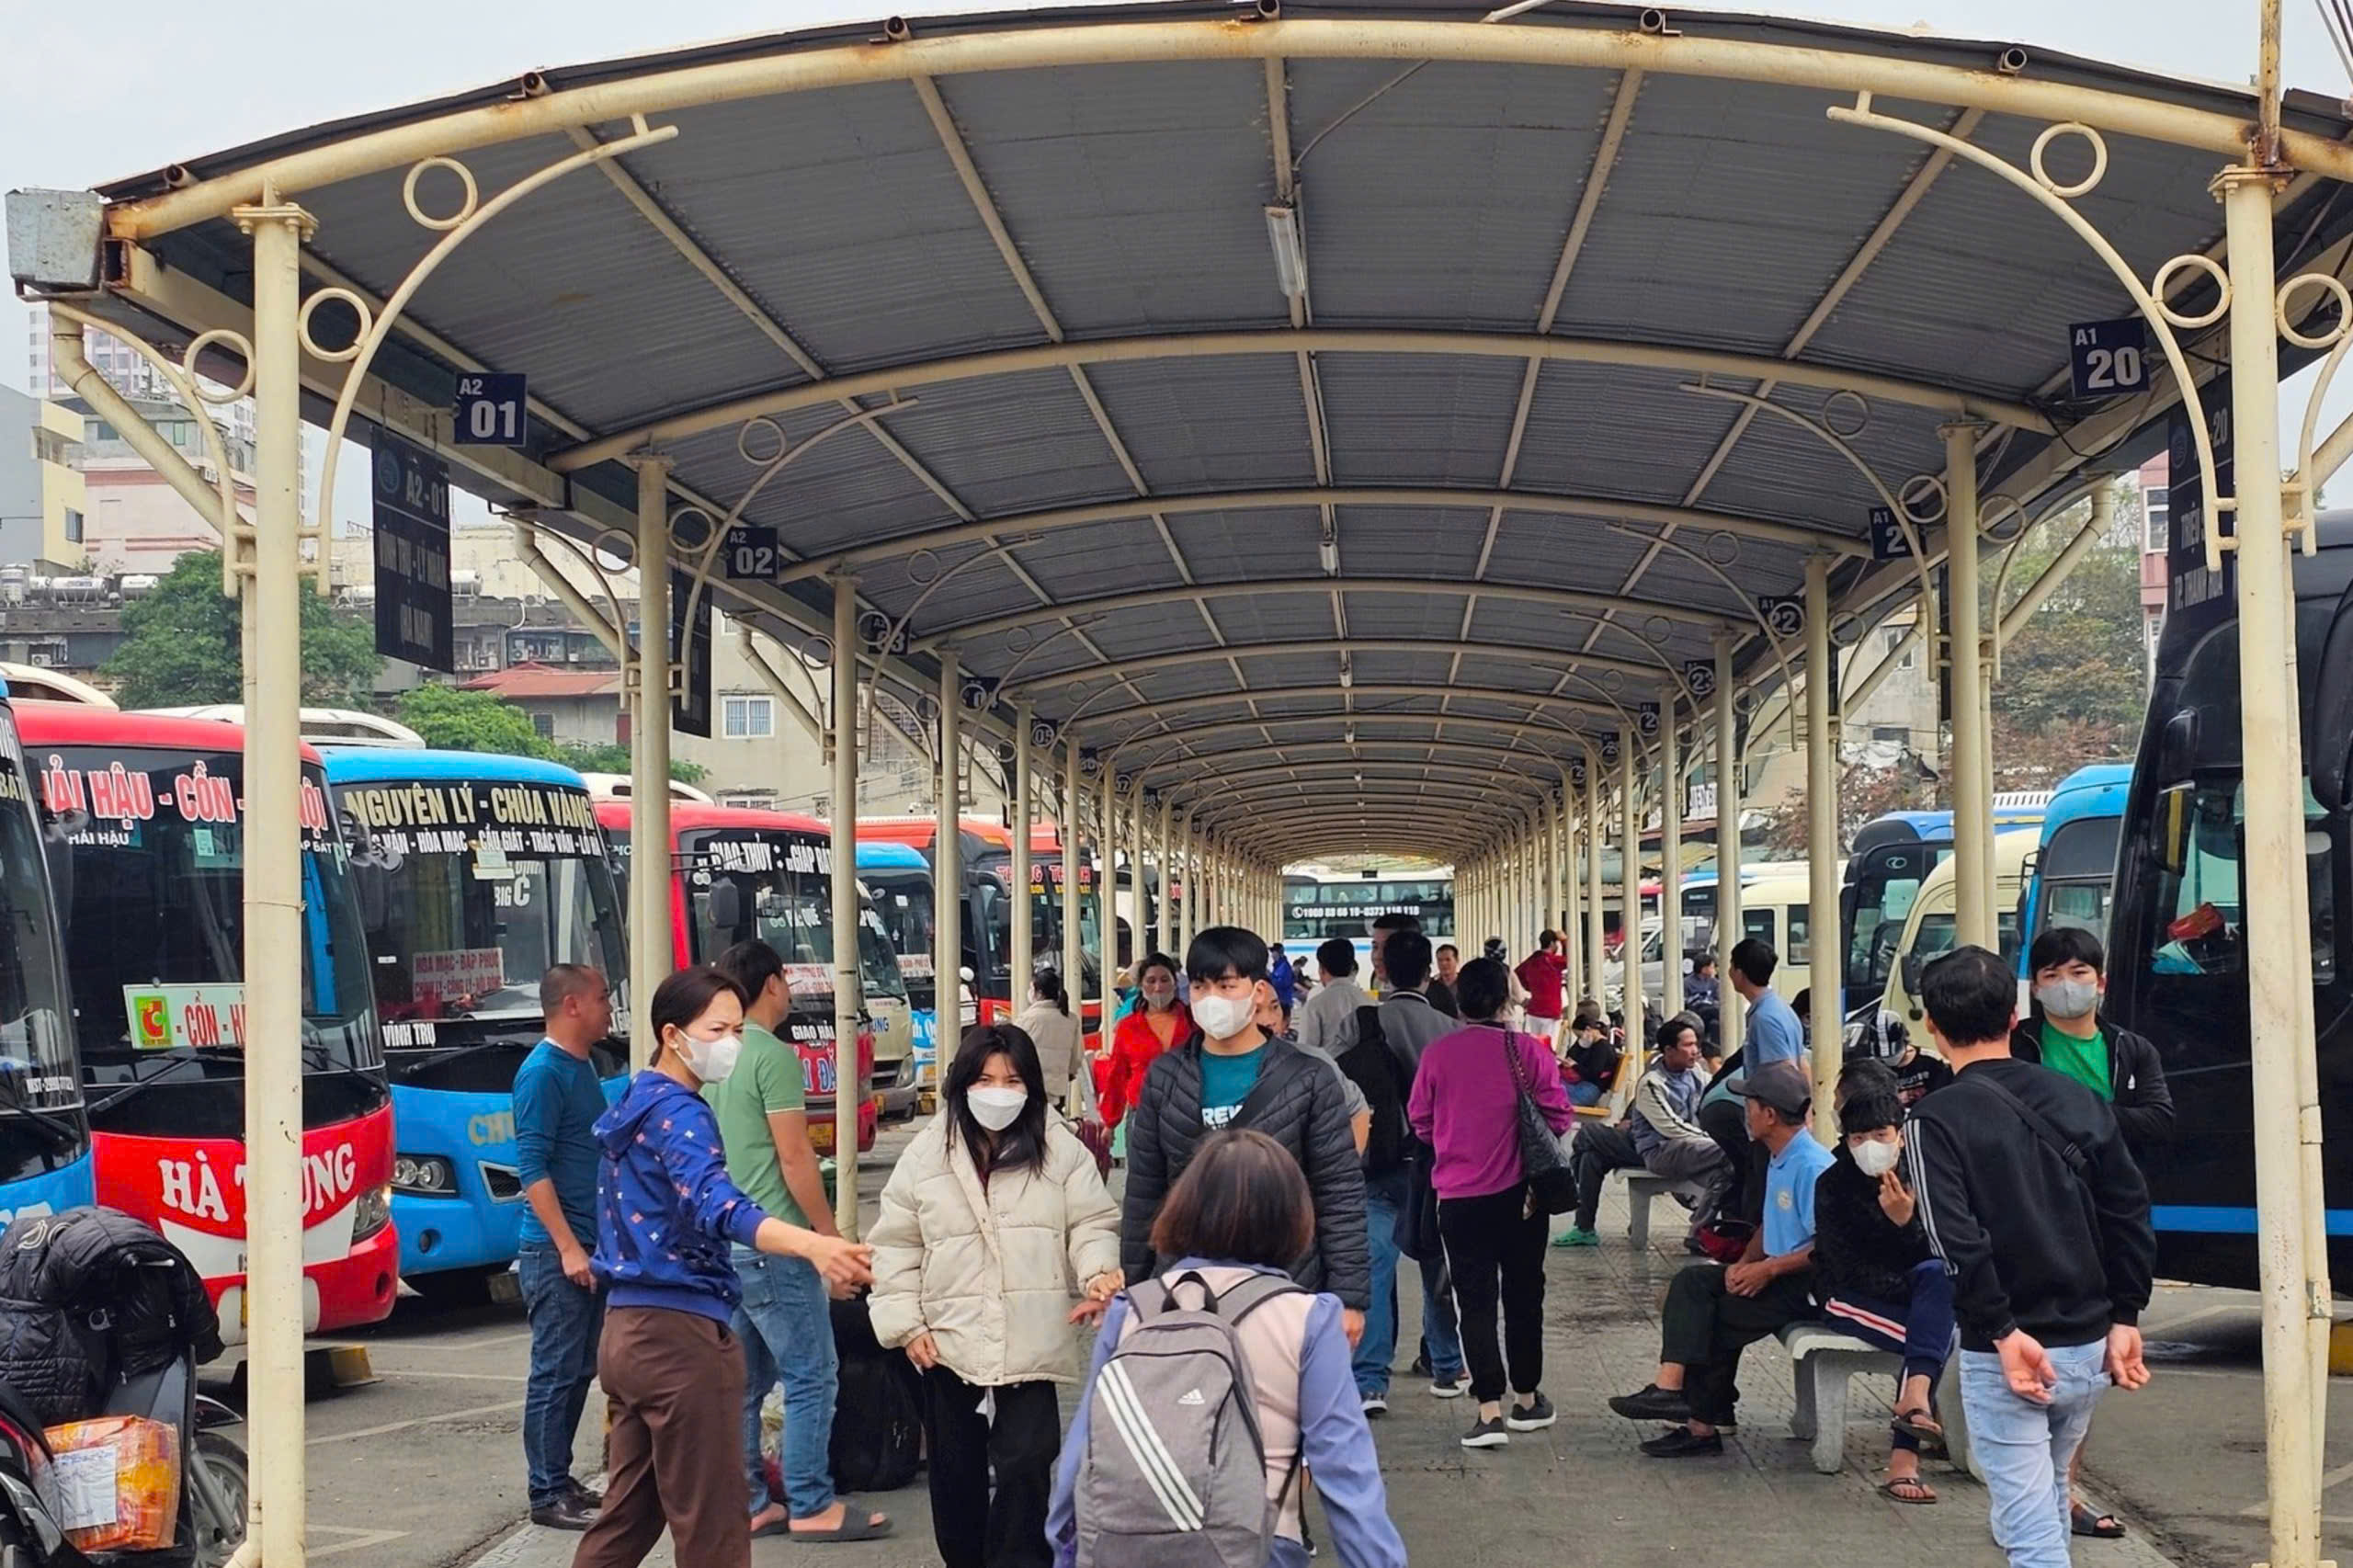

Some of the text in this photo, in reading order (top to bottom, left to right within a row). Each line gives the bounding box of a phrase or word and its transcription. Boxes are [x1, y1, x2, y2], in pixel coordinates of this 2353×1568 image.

[2075, 328, 2097, 347] A1
[2086, 347, 2142, 389] 20
[460, 378, 483, 396] A2
[471, 400, 517, 438] 01
[1873, 511, 1890, 524] A1
[730, 530, 746, 544] A2
[735, 547, 773, 575] 02
[88, 761, 153, 830] HẬU
[175, 760, 236, 824] CỒN
[345, 782, 448, 826] NGUYÊN
[449, 781, 476, 824] LÝ
[491, 783, 549, 826] CHÙA
[547, 787, 595, 831] VÀNG
[98, 830, 130, 848] HẬU
[416, 827, 442, 854] HÒA
[441, 830, 468, 856] MẠC
[501, 827, 524, 852] GIÁT
[529, 828, 556, 853] TRÁC
[554, 829, 575, 854] VĂN
[494, 876, 530, 907] BIG C
[185, 991, 220, 1046] CỒN
[791, 1025, 817, 1040] GIAO
[413, 1022, 436, 1048] TRỤ
[157, 1149, 229, 1222] HÀ
